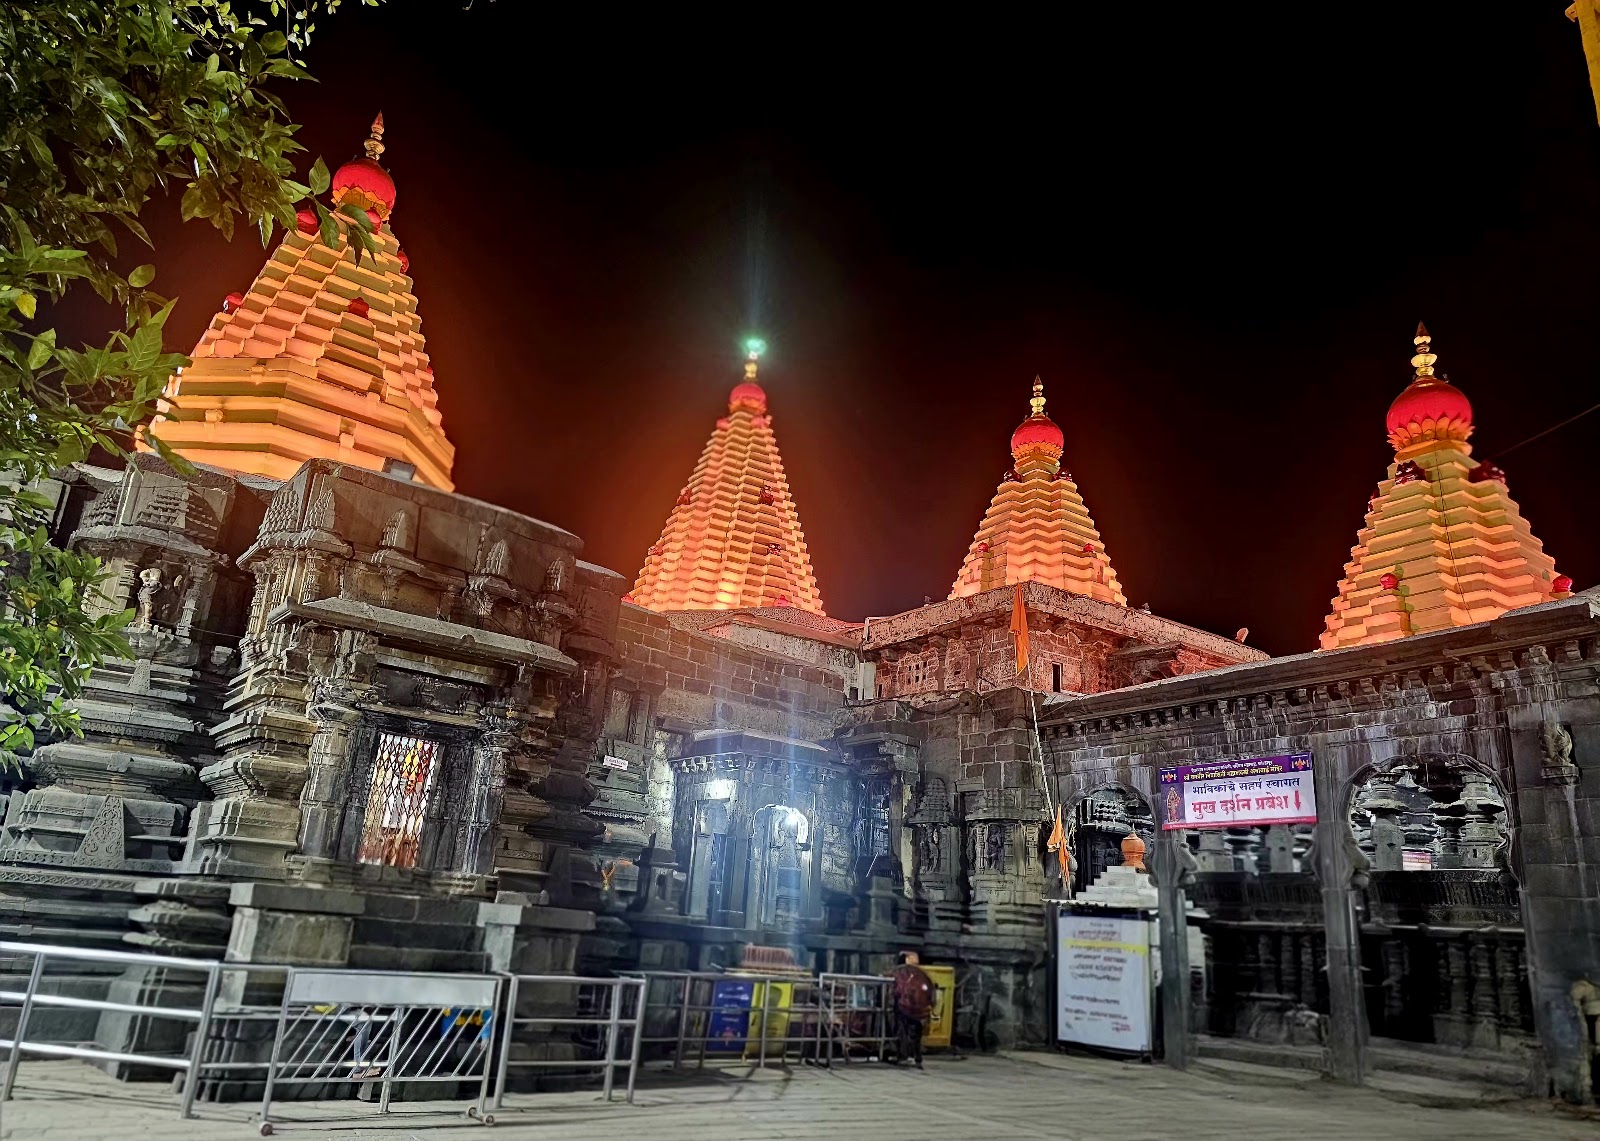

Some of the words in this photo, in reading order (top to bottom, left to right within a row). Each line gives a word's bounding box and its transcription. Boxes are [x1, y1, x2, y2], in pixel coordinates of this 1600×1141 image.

[1192, 780, 1236, 795] भाविकांचे
[1239, 778, 1263, 791] सहर्ष
[1266, 777, 1300, 788] स्वागत
[1192, 800, 1217, 819] मुख
[1219, 793, 1252, 815] दर्शन
[1255, 791, 1289, 811] प्रवेश
